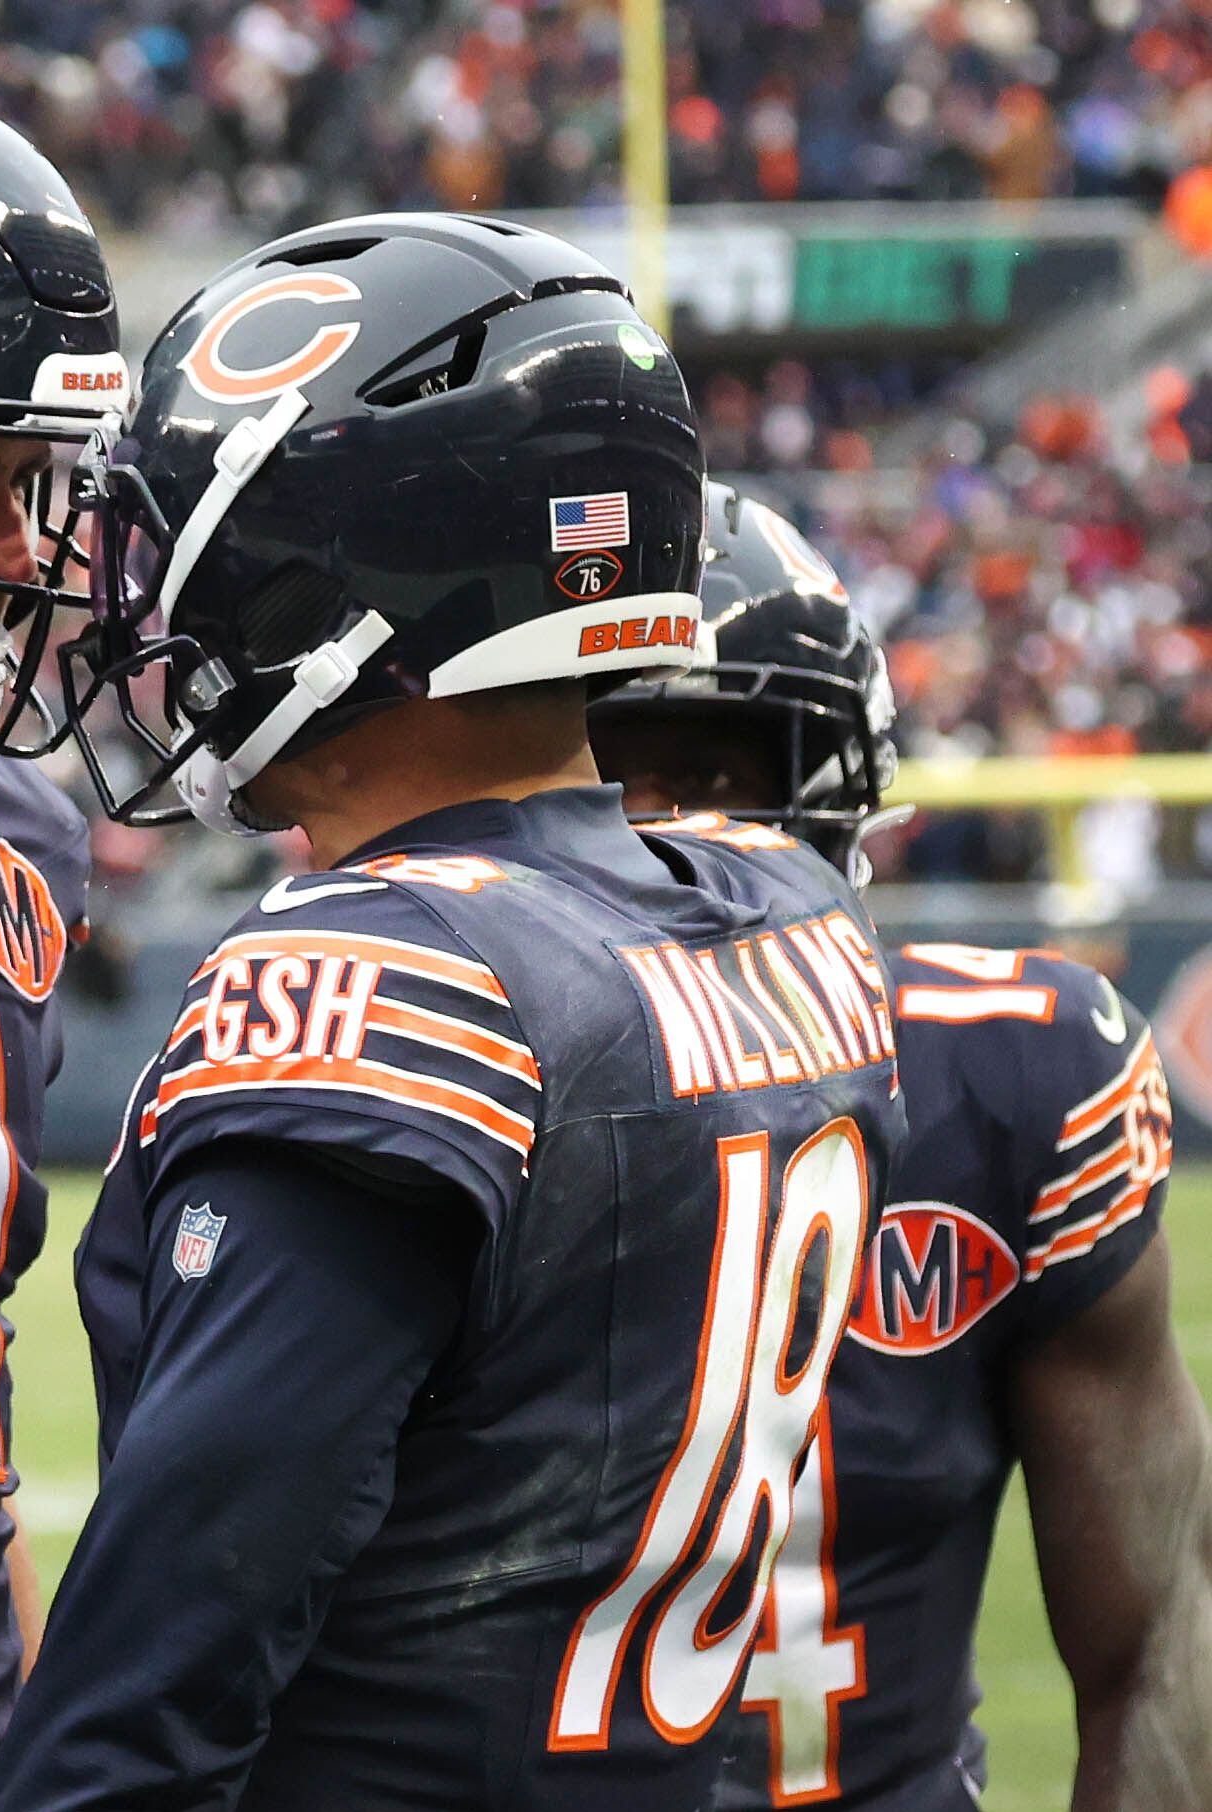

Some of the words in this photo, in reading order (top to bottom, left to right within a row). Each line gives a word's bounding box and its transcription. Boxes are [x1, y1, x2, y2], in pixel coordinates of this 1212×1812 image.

[62, 371, 123, 391] BEARS
[579, 567, 601, 595] 76
[201, 953, 383, 1064] GSH
[617, 910, 896, 1098] WILLIAMS
[177, 1233, 207, 1270] NFL
[547, 1116, 868, 1751] 18
